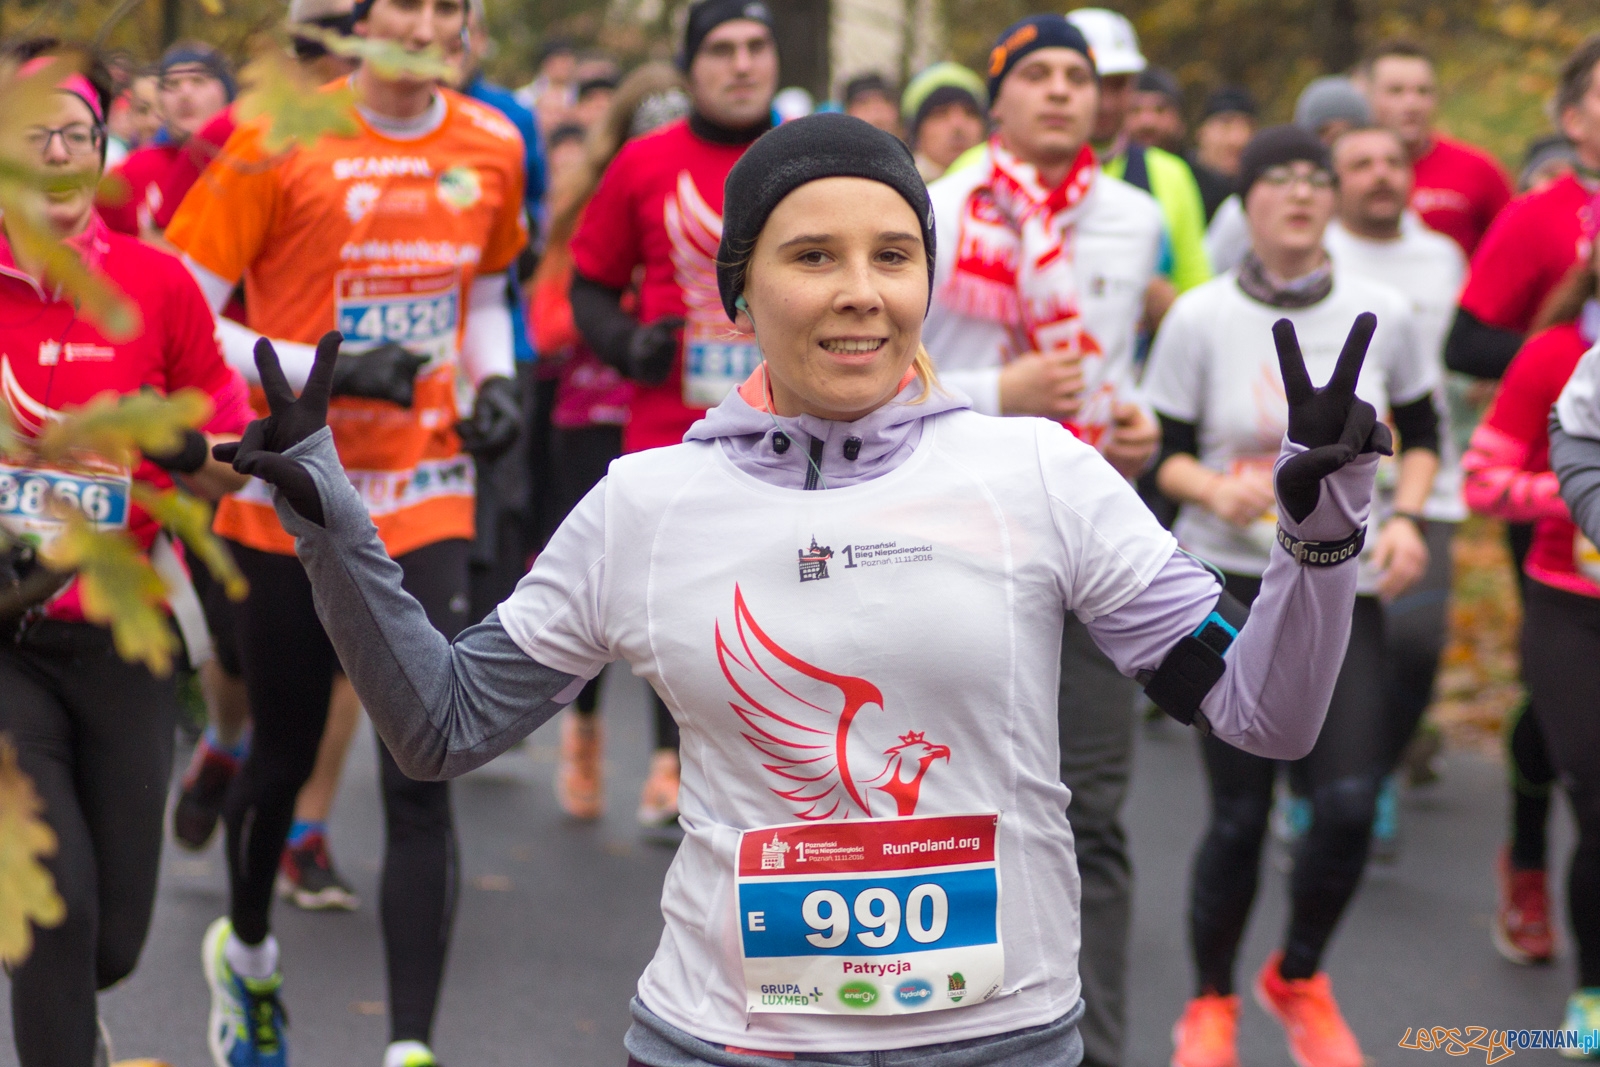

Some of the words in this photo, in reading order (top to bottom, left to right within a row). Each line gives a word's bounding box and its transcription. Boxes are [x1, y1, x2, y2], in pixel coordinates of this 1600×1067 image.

[356, 299, 451, 338] 4520
[855, 541, 897, 551] Poznański
[855, 551, 873, 559] Bieg
[874, 545, 933, 557] Niepodległości
[841, 544, 858, 569] 1
[894, 554, 933, 564] 11.11.2016
[794, 841, 807, 862] 1
[820, 846, 865, 855] Niepodległości
[882, 837, 980, 855] RunPoland.org
[748, 911, 766, 932] E
[801, 883, 949, 949] 990
[842, 960, 912, 977] Patrycja
[761, 984, 802, 994] GRUPA
[761, 995, 809, 1006] LUXMED
[844, 991, 875, 1002] energy
